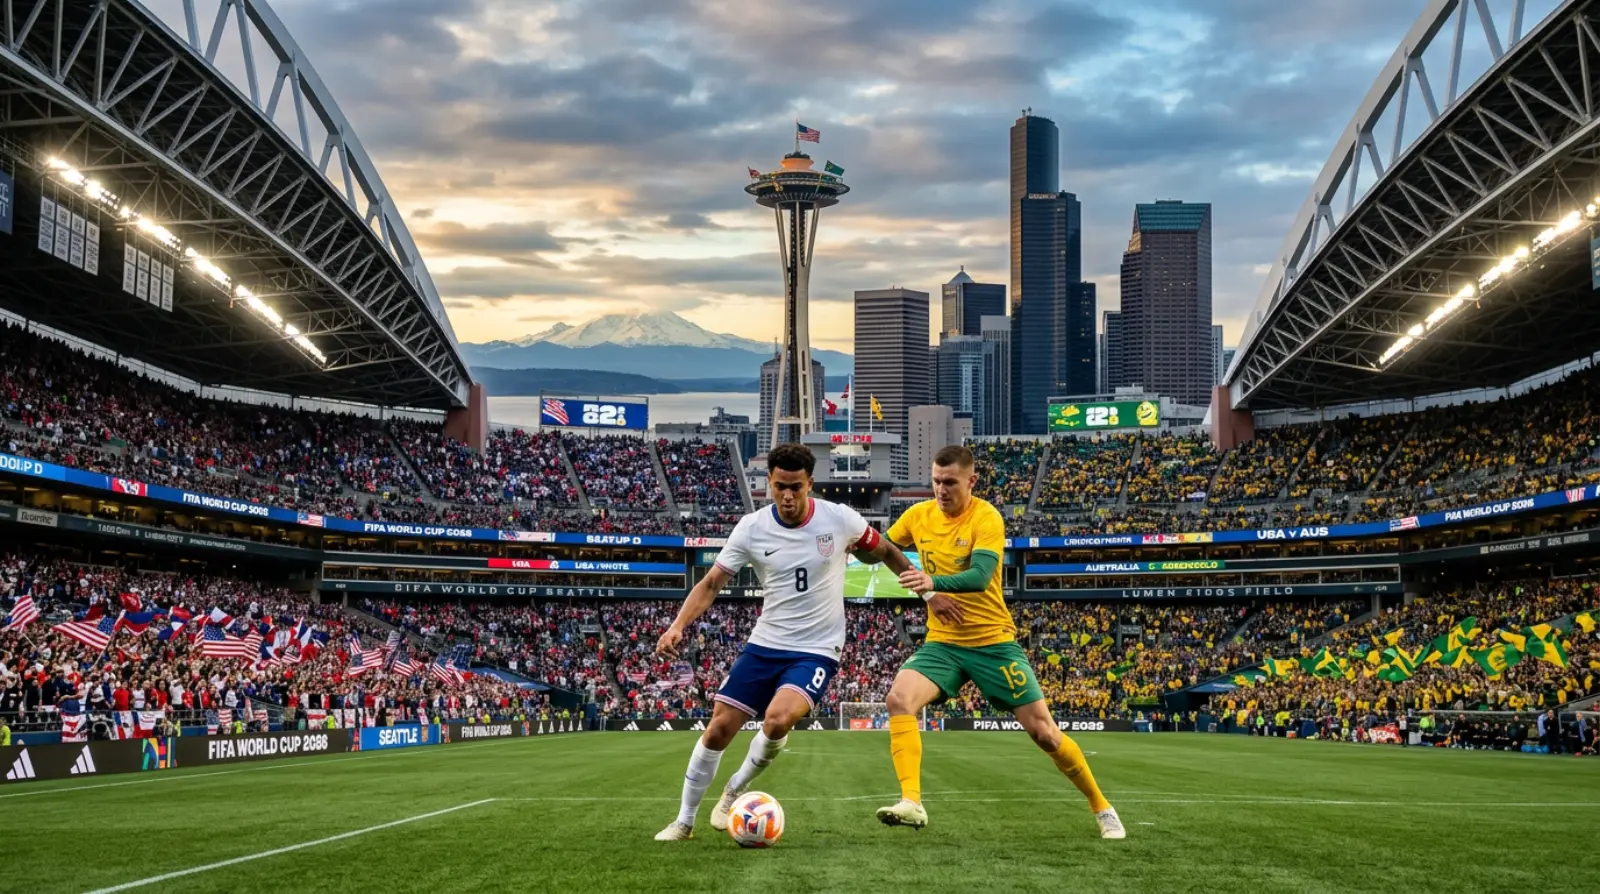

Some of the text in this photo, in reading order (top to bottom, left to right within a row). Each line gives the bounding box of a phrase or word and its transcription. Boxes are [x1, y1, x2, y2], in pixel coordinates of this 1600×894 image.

[387, 524, 423, 535] WORLD
[424, 526, 445, 536] CUP
[1300, 527, 1329, 538] AUS
[921, 550, 937, 575] 15
[441, 585, 498, 595] WORLD
[506, 586, 537, 595] CUP
[794, 567, 809, 593] 8
[1122, 589, 1176, 598] LUMEN
[811, 666, 826, 689] 8
[1000, 662, 1028, 690] 15
[379, 726, 418, 746] SEATTLE
[208, 737, 236, 760] FIFA
[237, 734, 278, 757] WORLD
[279, 734, 301, 754] CUP
